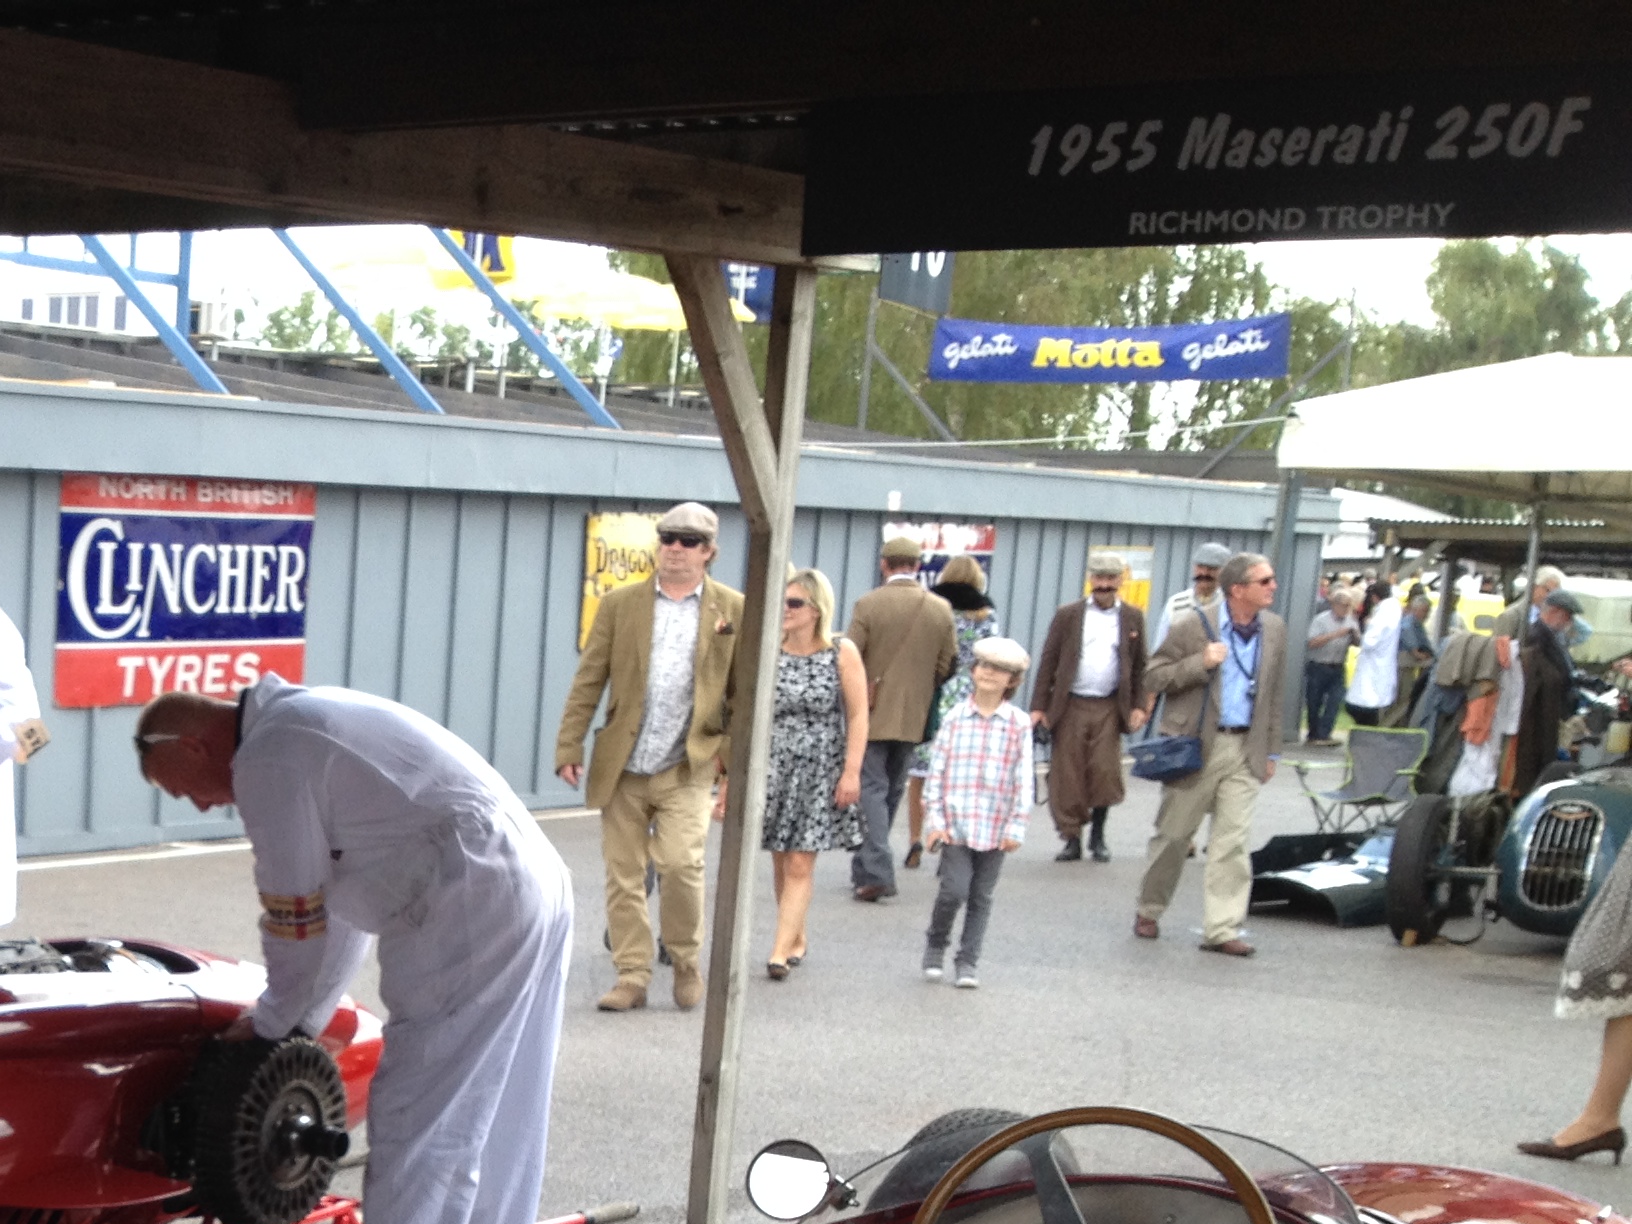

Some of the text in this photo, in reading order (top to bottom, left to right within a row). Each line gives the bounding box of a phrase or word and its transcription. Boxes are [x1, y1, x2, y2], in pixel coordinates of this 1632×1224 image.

[1027, 96, 1592, 177] 1955 Maserati 250F
[1127, 202, 1456, 237] RICHMOND TROPHY
[942, 331, 1020, 369] gelati
[1030, 336, 1167, 369] Motta
[97, 475, 295, 506] NORTH BRITISH
[68, 517, 307, 640] CLINCHER
[116, 651, 262, 703] TYRES
